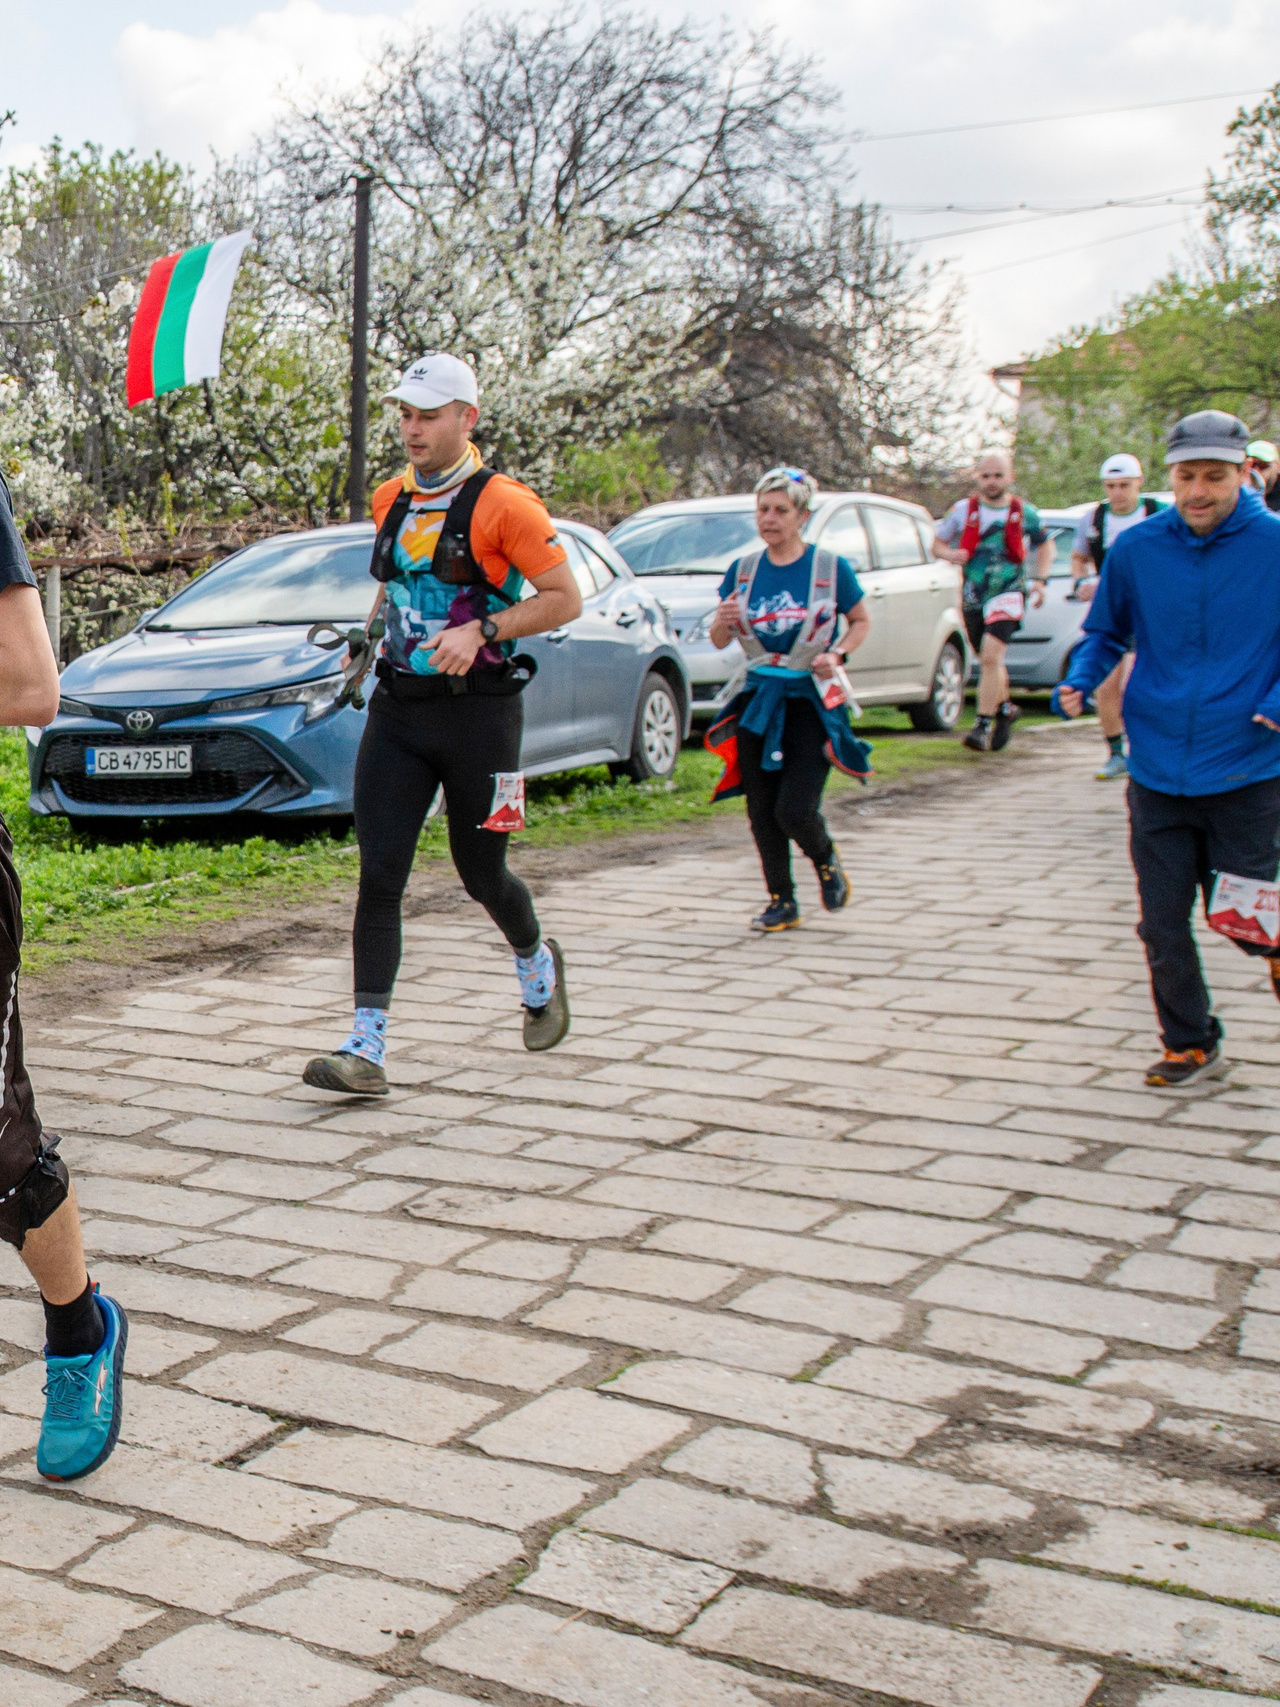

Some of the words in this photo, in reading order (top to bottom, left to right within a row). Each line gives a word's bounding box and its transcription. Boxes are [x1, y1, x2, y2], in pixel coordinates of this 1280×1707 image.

[98, 752, 119, 770] CB
[123, 750, 163, 770] 4795
[166, 750, 188, 769] HC
